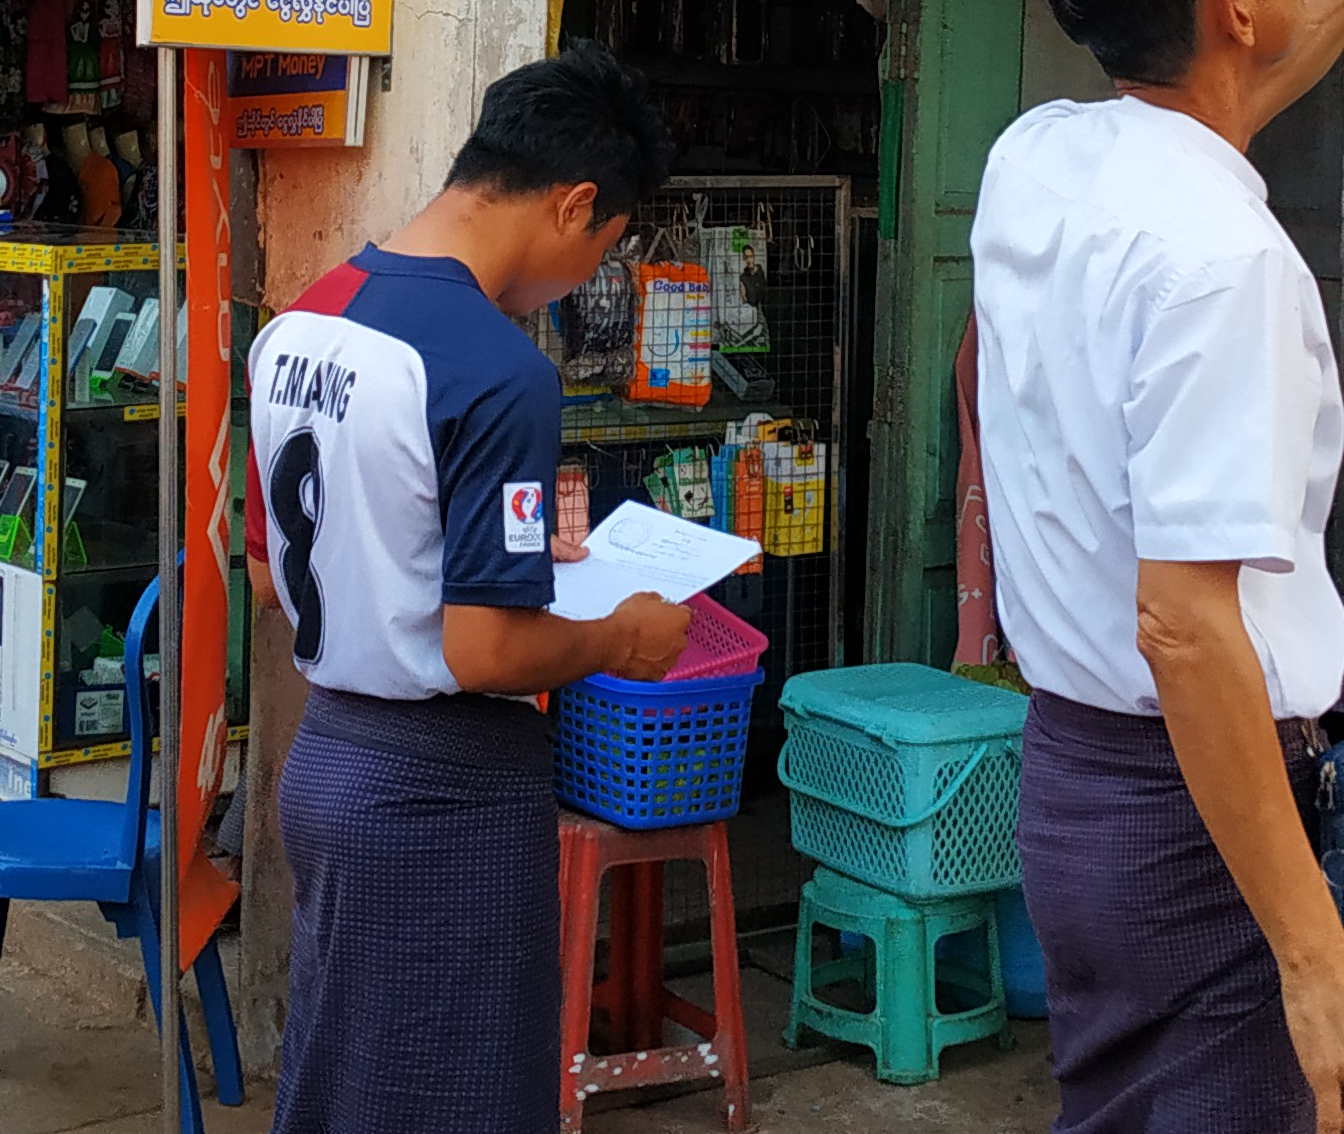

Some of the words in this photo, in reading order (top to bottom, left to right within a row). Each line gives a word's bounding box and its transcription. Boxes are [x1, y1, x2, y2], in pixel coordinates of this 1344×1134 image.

[241, 54, 275, 79] MPT
[277, 54, 325, 80] Money
[654, 280, 685, 293] Good
[266, 425, 325, 666] 8
